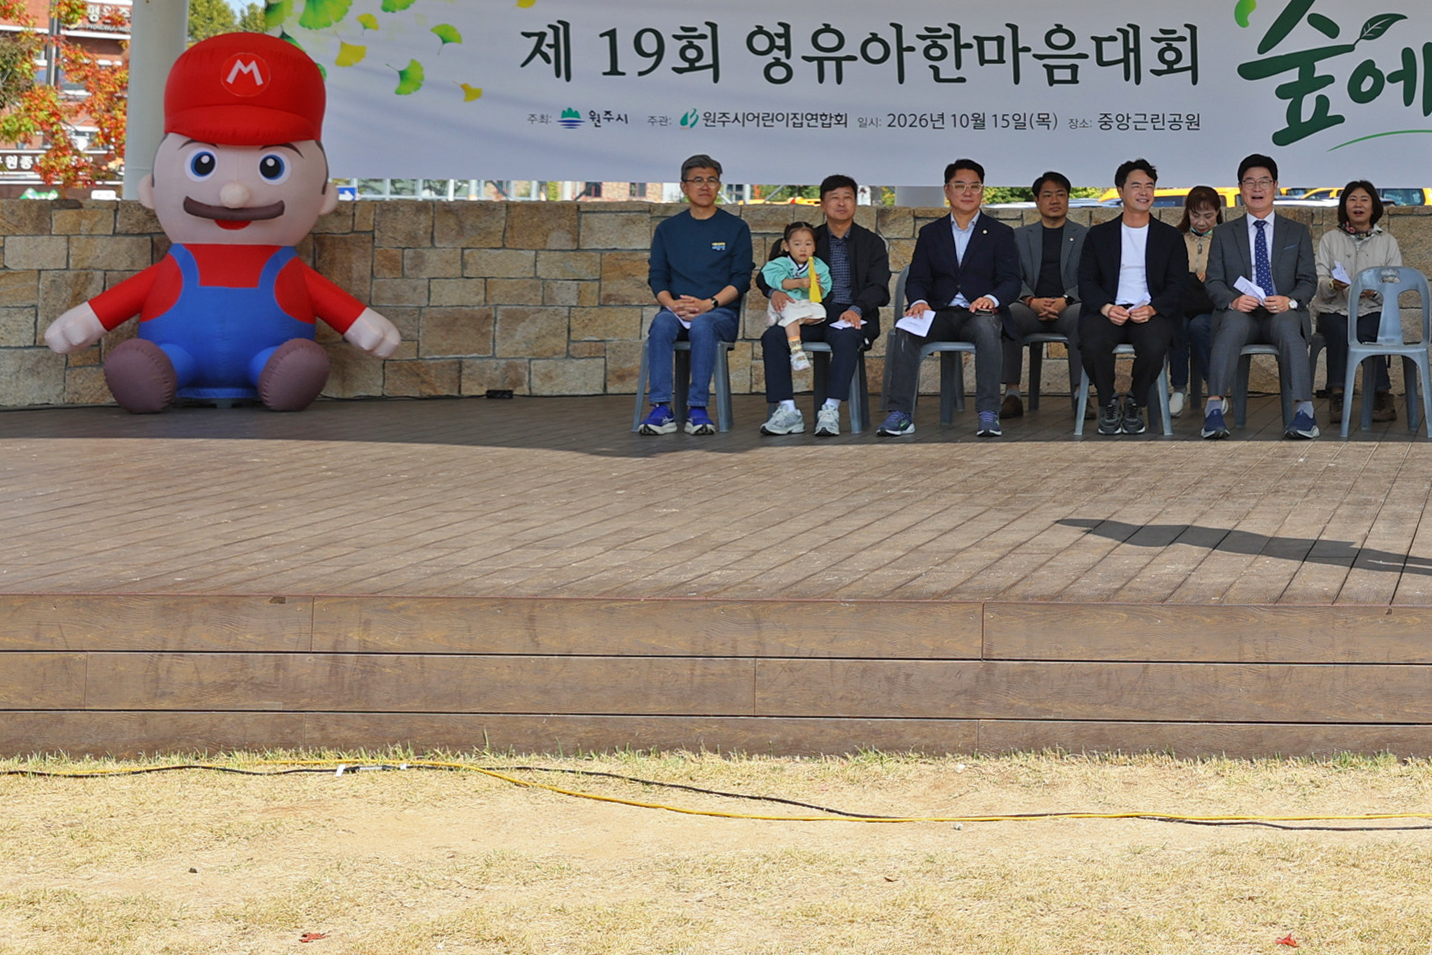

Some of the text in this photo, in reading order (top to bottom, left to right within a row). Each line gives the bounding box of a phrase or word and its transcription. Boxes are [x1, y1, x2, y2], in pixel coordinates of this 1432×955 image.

[520, 19, 1198, 87] 제 19회 영유아한마음대회
[226, 59, 264, 86] M
[527, 109, 1201, 132] 주최: 원주시 주관: 원주시어린이집연합회 일시: 2026년 10월 15일(목) 장소: 중앙근린공원
